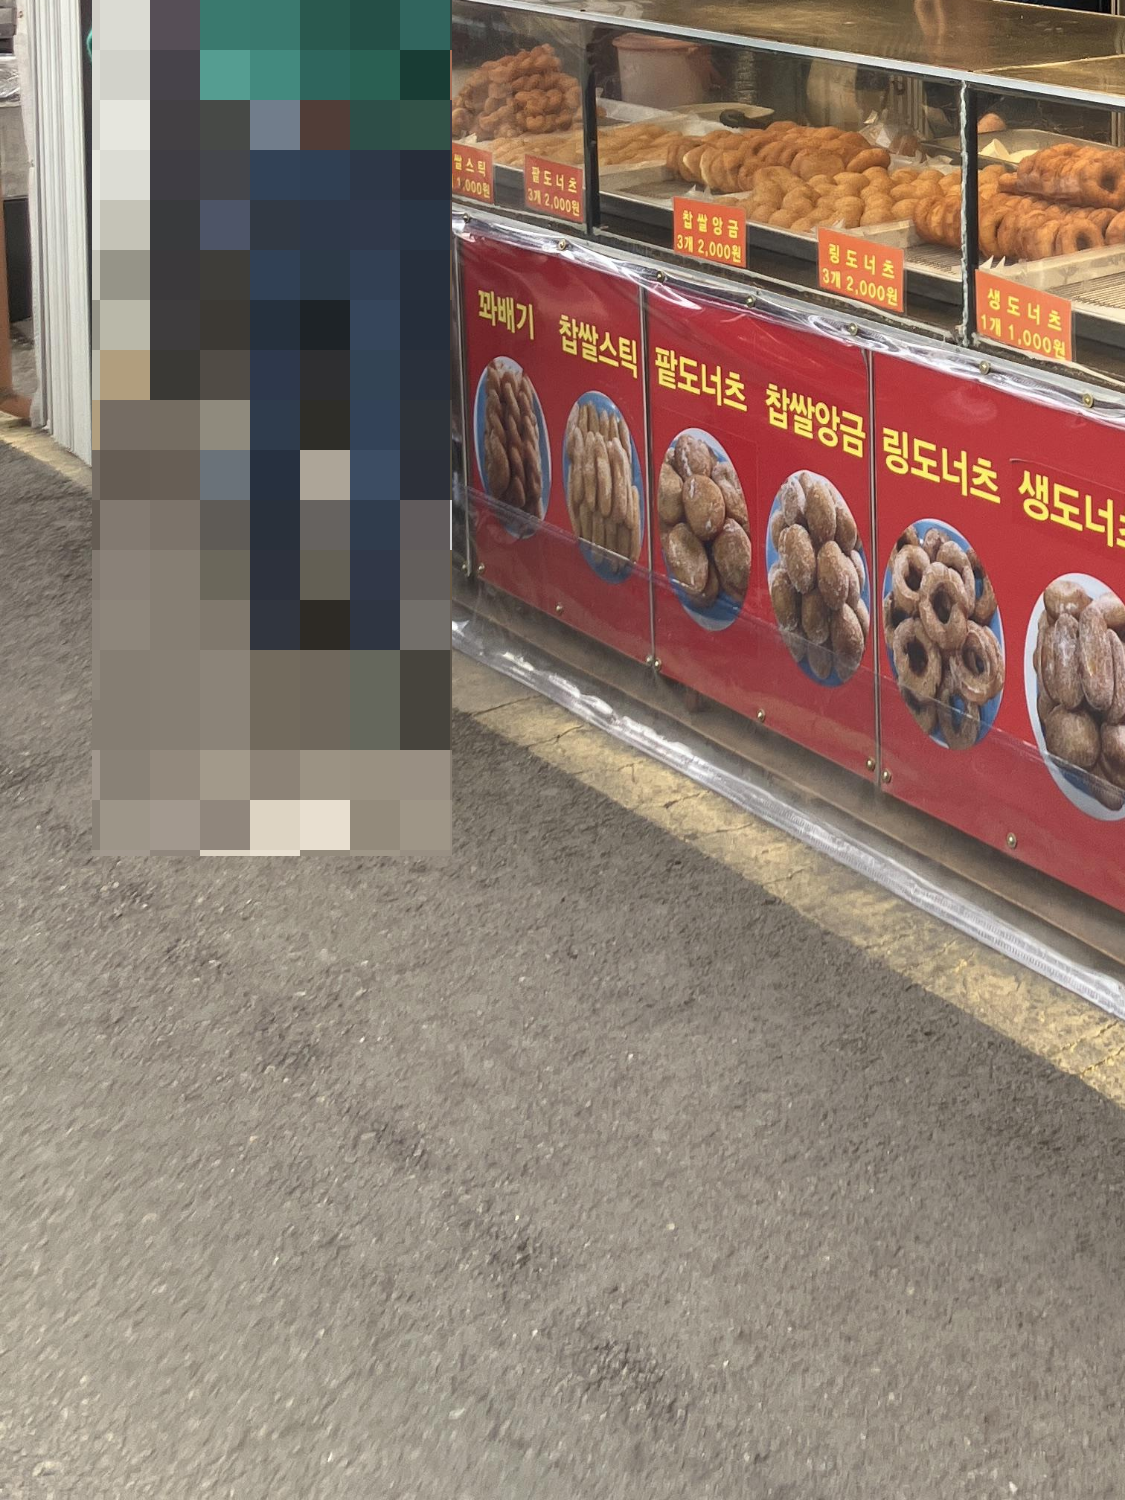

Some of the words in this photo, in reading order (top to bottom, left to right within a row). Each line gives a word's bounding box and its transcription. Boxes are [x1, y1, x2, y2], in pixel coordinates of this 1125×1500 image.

[527, 188, 542, 208] 3개
[544, 192, 580, 217] 2,000원
[682, 210, 739, 238] 찹쌀앙금
[677, 234, 694, 251] 3개
[697, 239, 742, 263] 2,000원
[829, 243, 895, 279] 링도너츠
[822, 268, 841, 288] 3개
[846, 276, 898, 305] 2,000원
[478, 289, 535, 340] 꽈배기
[987, 288, 1063, 332] 생도너츠
[558, 314, 638, 379] 찹쌀스틱
[981, 314, 1002, 338] 1개
[1008, 324, 1066, 361] 1,000원
[654, 346, 748, 412] 팥도너츠
[764, 383, 866, 458] 찹쌀앙금
[883, 427, 1000, 504] 링도너츠
